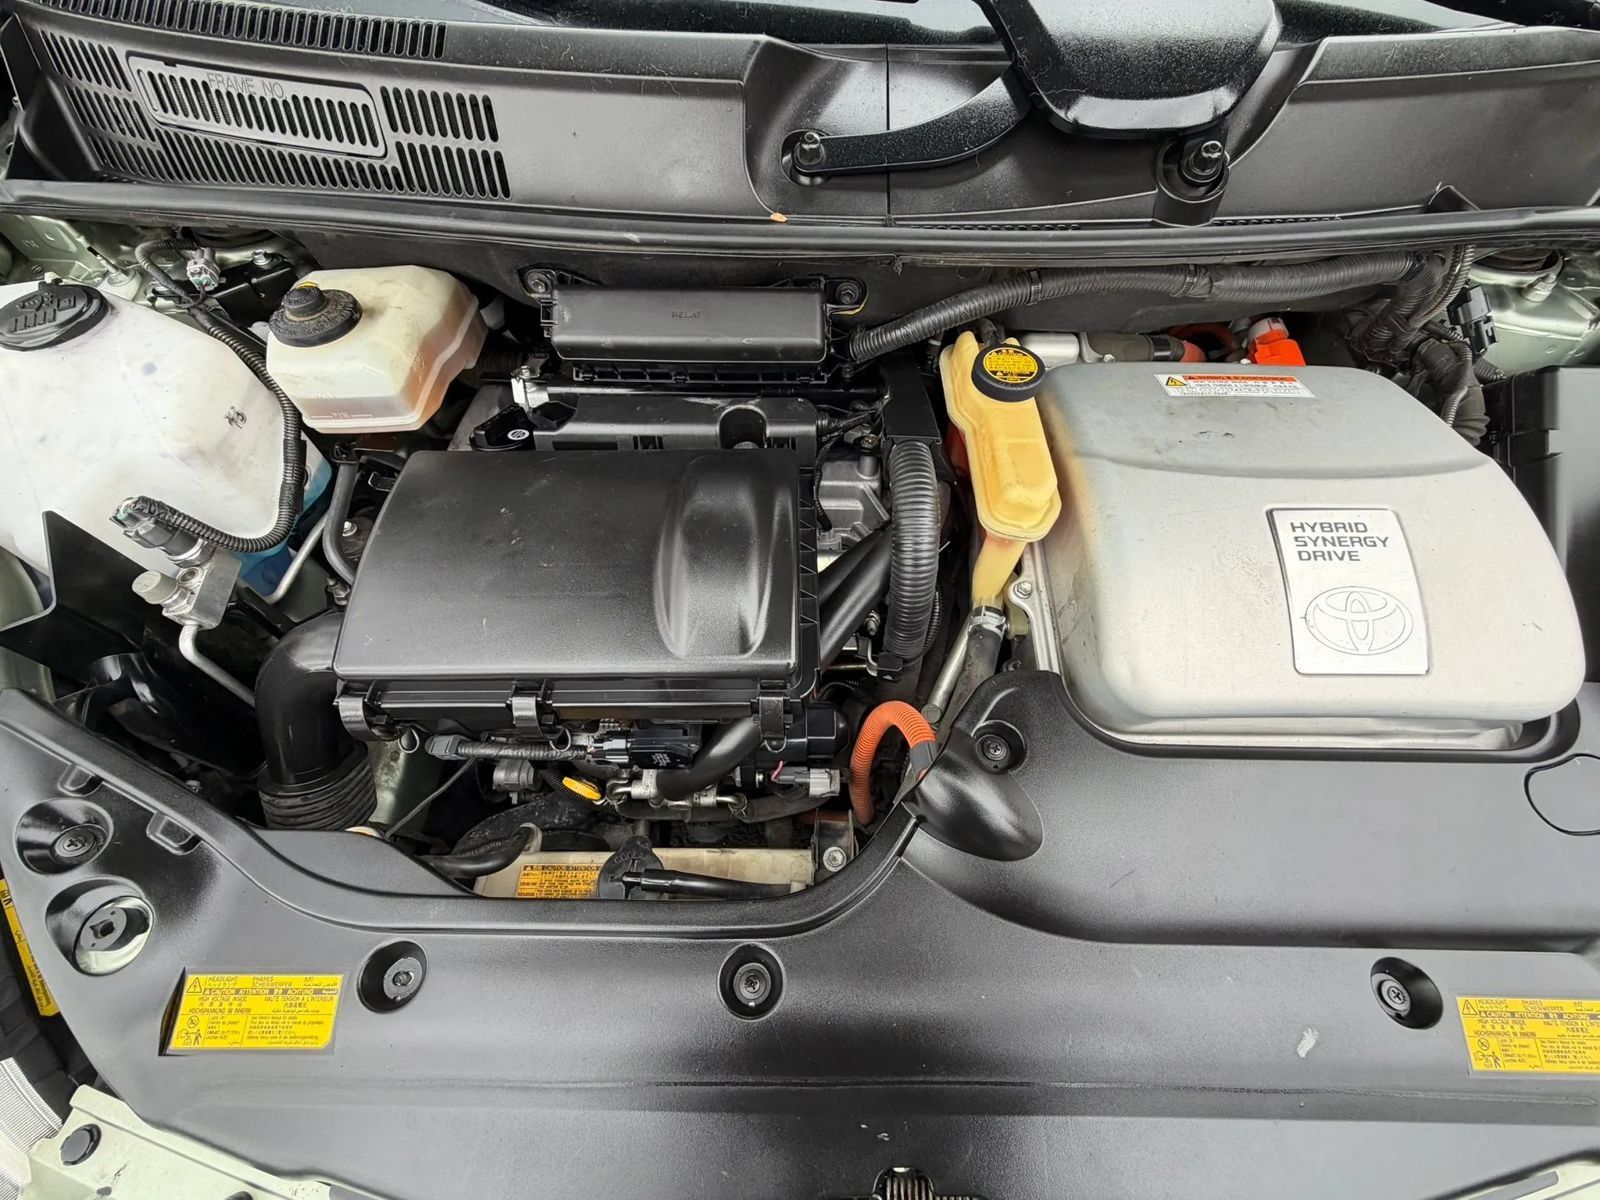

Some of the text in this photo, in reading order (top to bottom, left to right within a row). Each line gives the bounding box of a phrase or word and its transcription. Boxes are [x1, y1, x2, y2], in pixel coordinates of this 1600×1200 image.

[207, 73, 288, 99] FRAME NO.
[1290, 522, 1368, 533] HYBRID
[1294, 536, 1389, 547] SYNERGY
[1297, 550, 1361, 561] DRIVE
